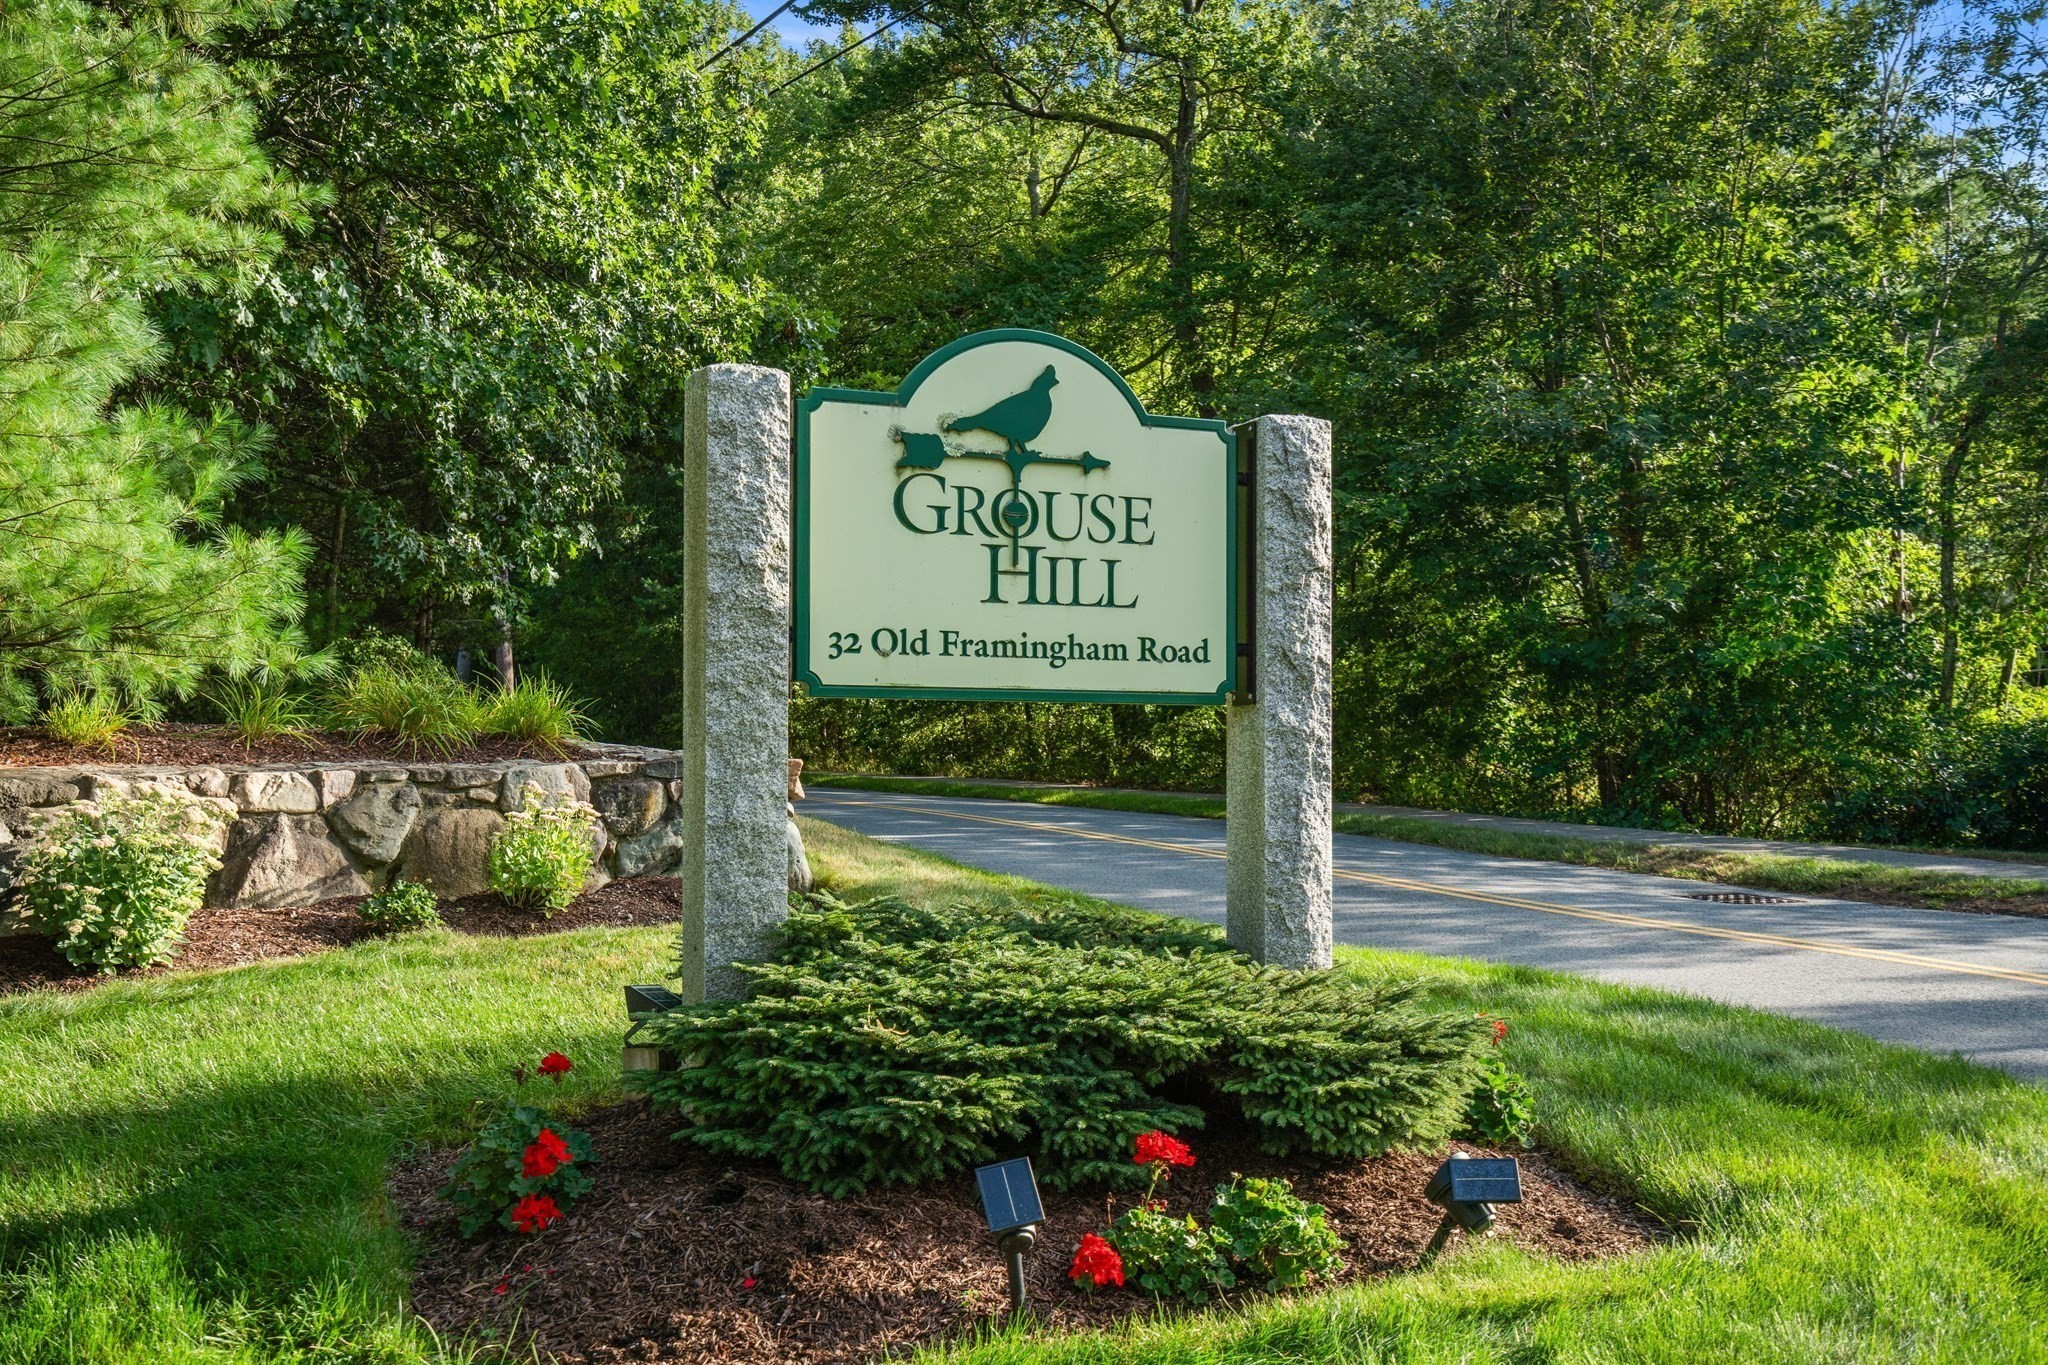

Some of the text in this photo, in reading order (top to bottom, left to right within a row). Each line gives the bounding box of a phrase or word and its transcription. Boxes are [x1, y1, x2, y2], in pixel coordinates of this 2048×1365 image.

[892, 472, 1156, 546] GROUSE
[980, 543, 1139, 609] HILL
[828, 627, 1211, 669] 32 Old Framingham Road
